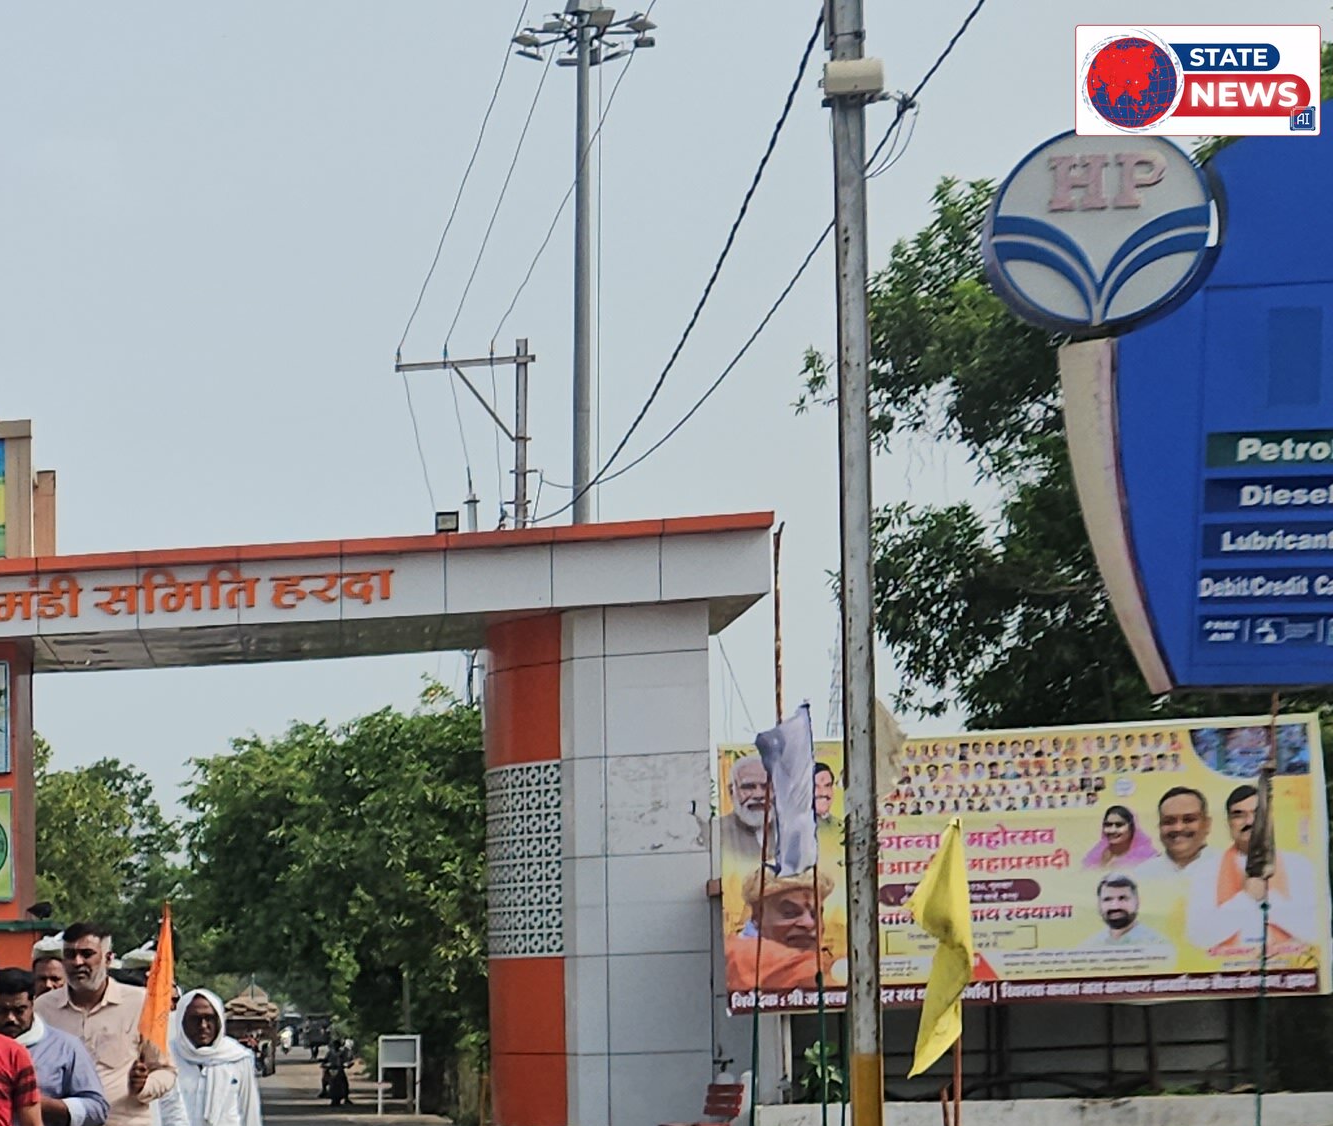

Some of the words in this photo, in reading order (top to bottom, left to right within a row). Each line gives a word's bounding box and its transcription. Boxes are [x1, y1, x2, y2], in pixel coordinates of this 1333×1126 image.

[1048, 154, 1167, 213] HP
[1237, 438, 1333, 462] Petro
[93, 565, 261, 616] समिति
[270, 569, 394, 609] हरदा
